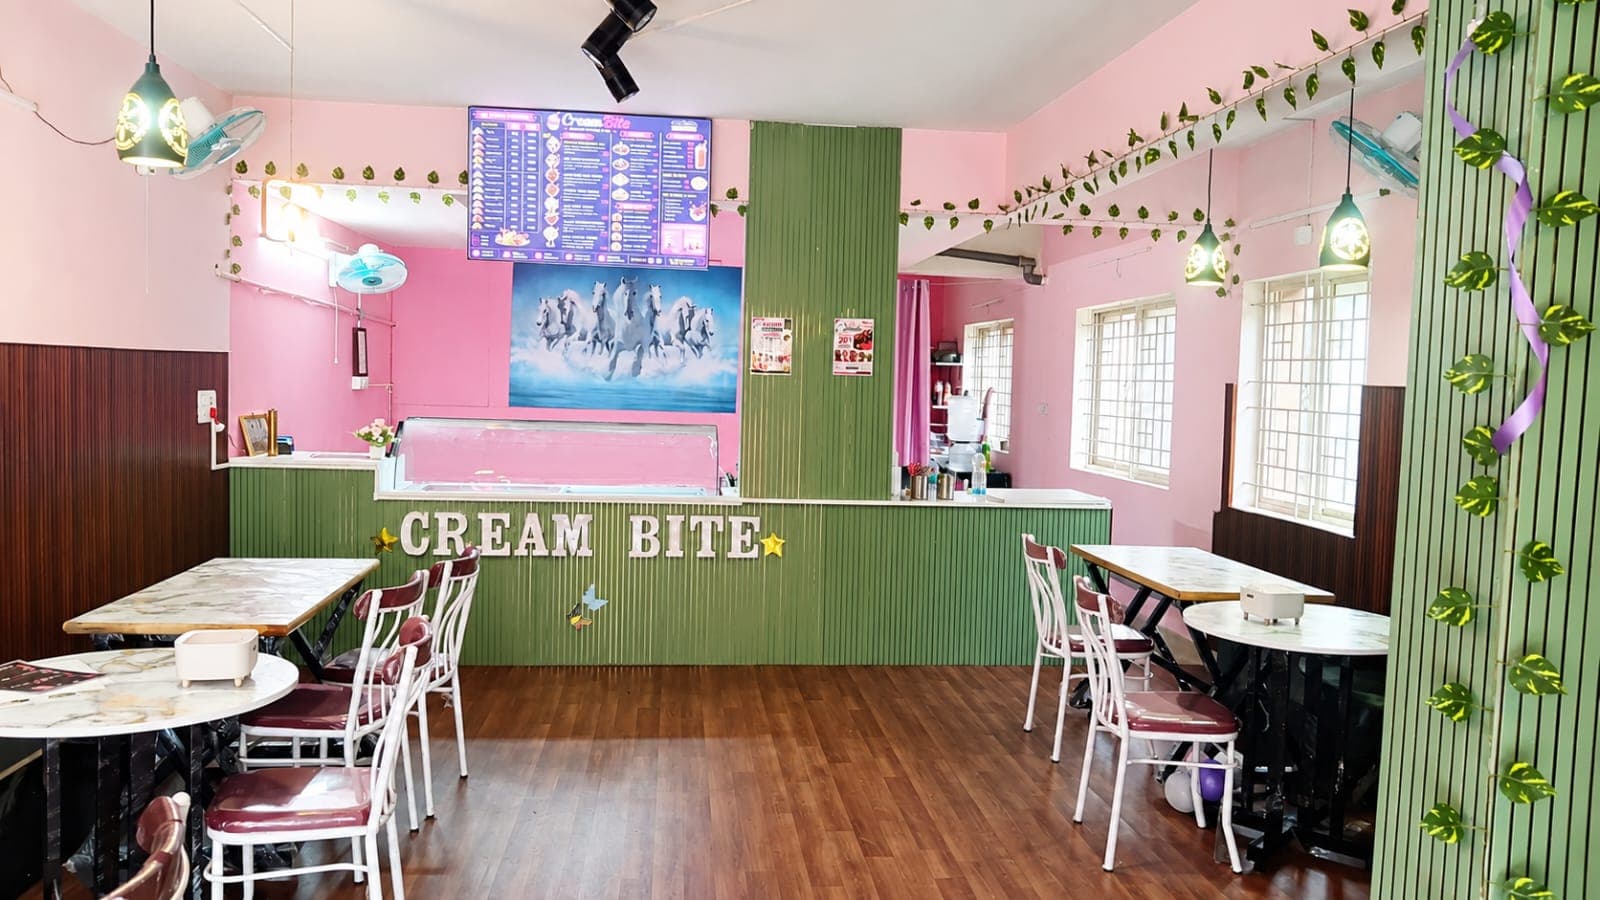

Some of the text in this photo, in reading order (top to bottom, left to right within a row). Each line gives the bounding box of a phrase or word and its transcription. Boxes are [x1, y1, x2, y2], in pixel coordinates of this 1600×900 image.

[562, 112, 631, 129] Cream Bite
[400, 511, 761, 559] CREAM BITE
